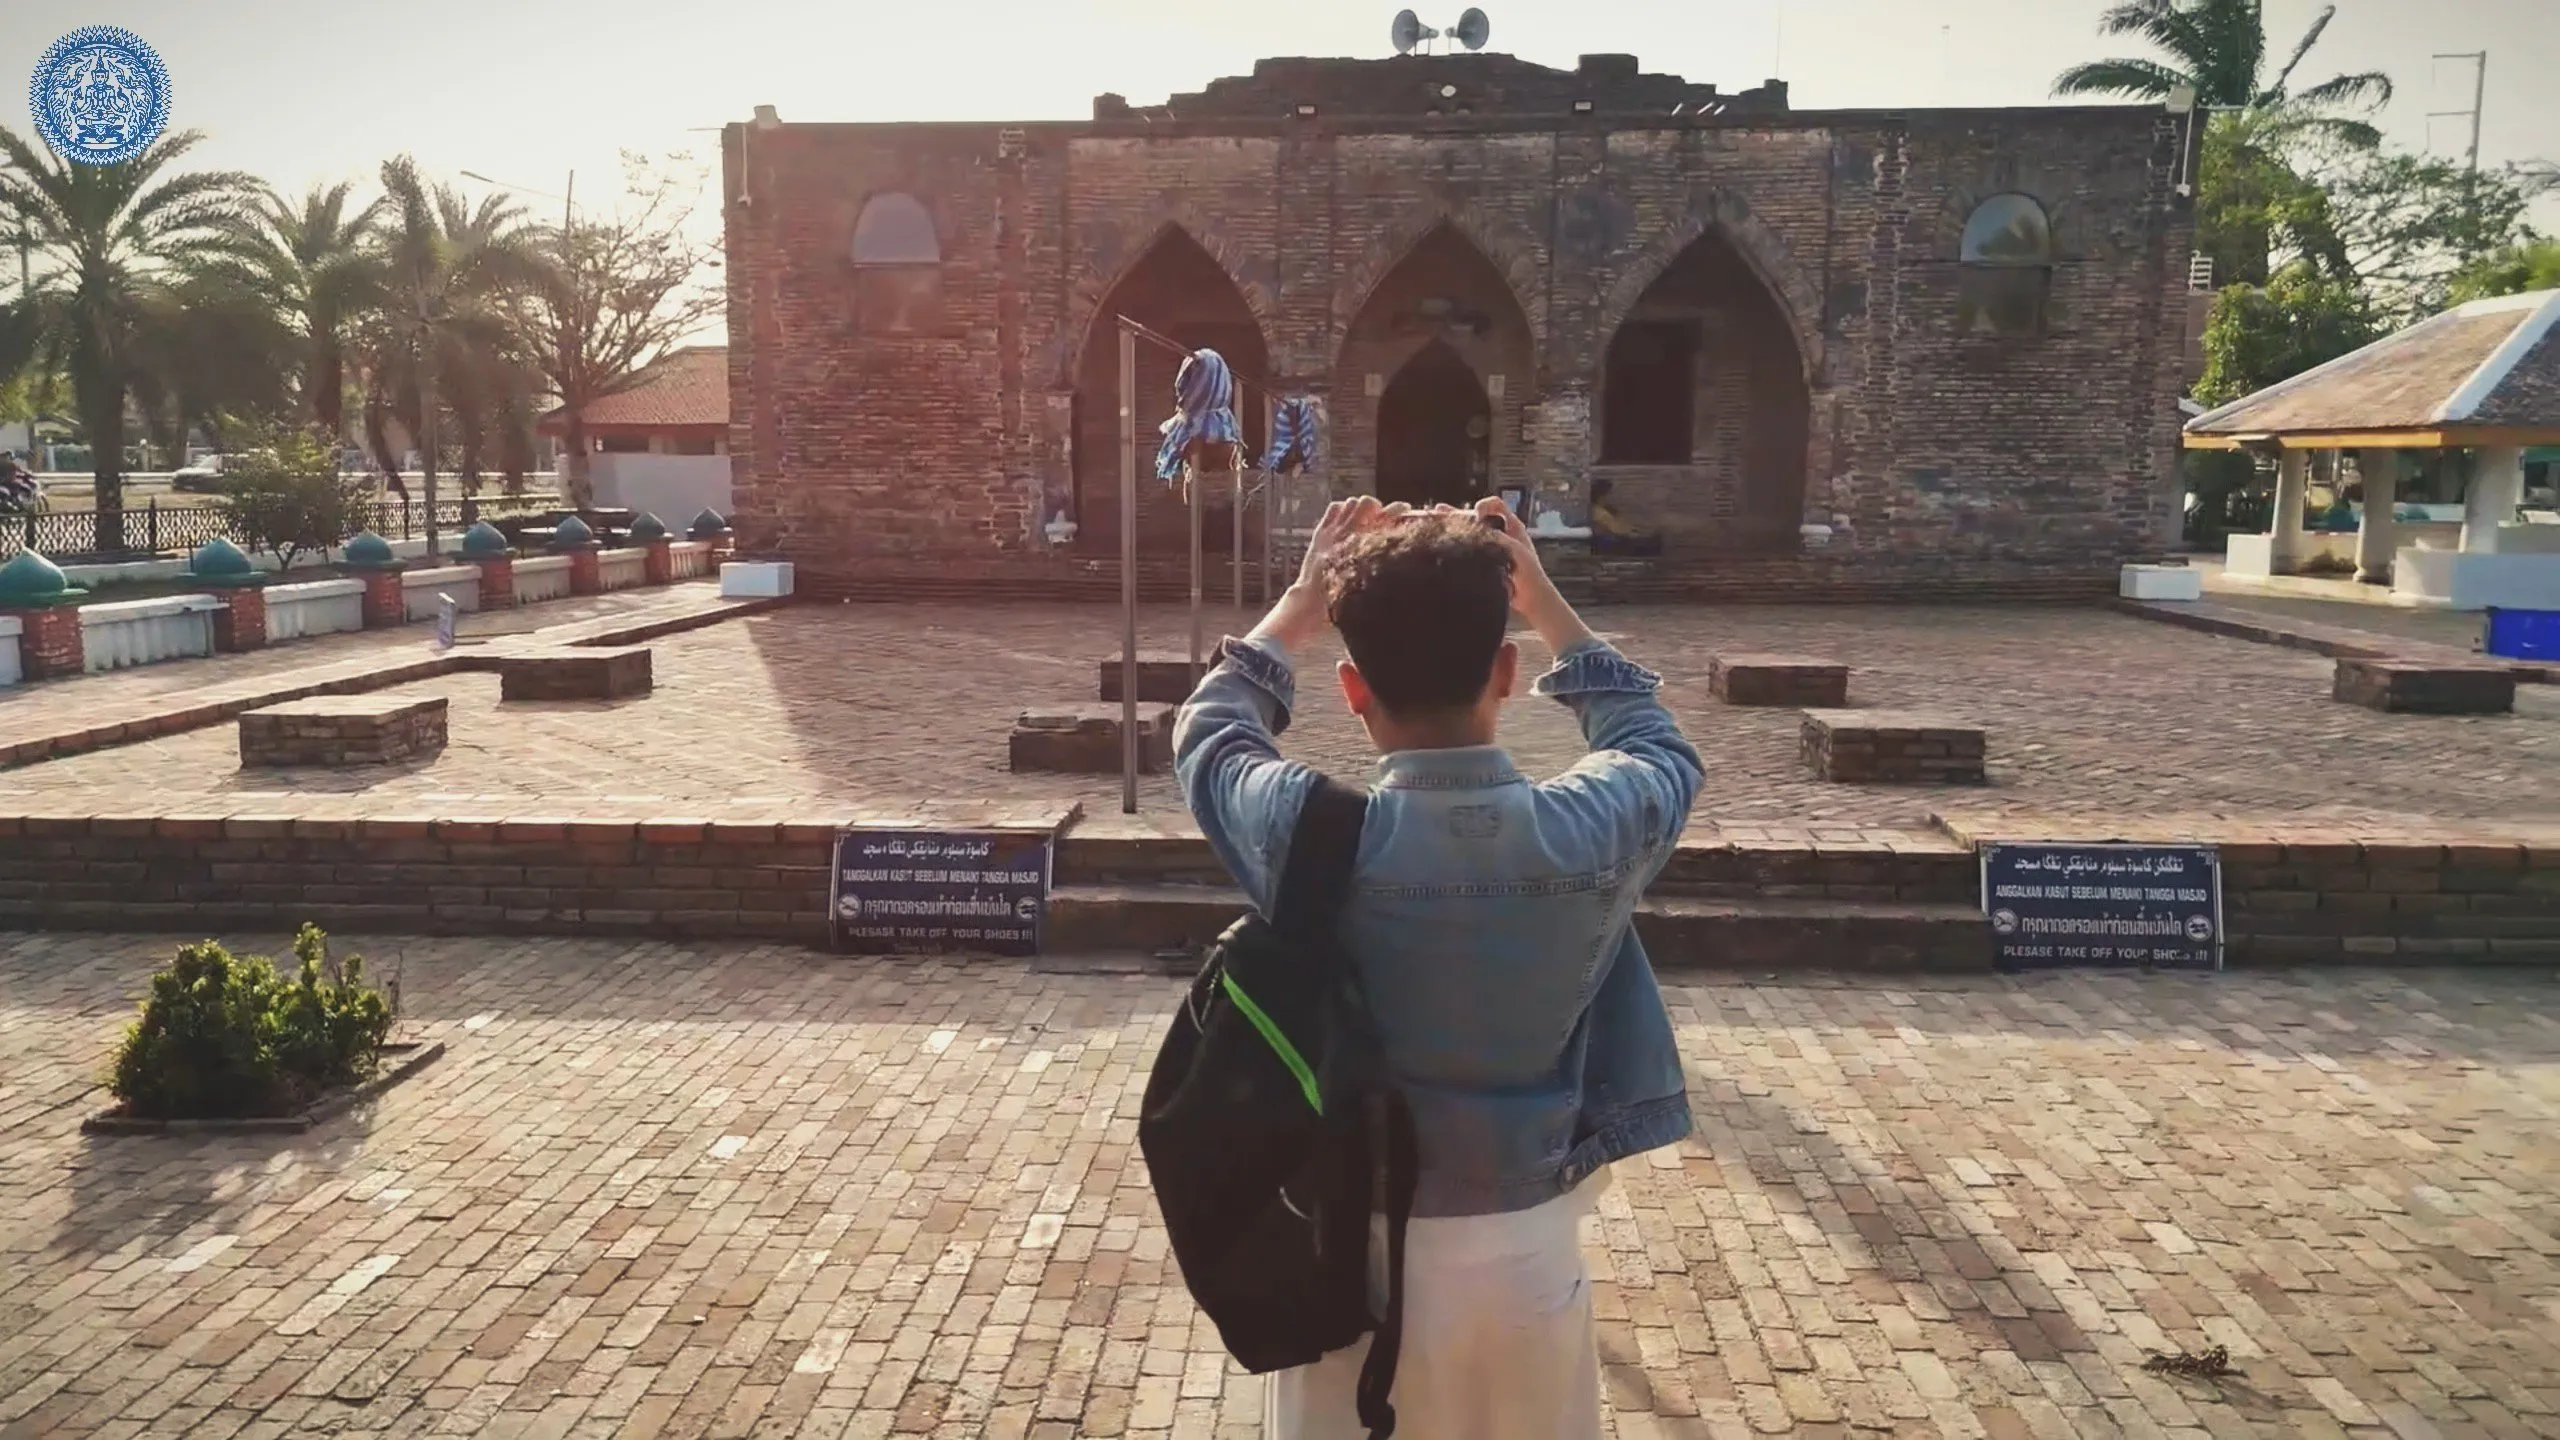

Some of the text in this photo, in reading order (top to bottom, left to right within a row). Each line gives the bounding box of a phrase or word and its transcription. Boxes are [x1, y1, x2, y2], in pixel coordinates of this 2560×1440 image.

[914, 869, 948, 883] SEBELUM
[981, 871, 1009, 884] TANGGA
[1011, 871, 1039, 884] MASJID
[2044, 885, 2069, 899] KASUT
[2071, 886, 2108, 900] SEBELUM
[2144, 888, 2175, 901] TANGGA
[2177, 888, 2207, 902] MASJID
[899, 927, 925, 938] TAKE
[952, 928, 981, 940] YOUR
[984, 929, 1018, 940] SHOES
[2057, 946, 2087, 958] TAKE
[2091, 946, 2113, 959] OFF
[2153, 948, 2190, 960] SHO
